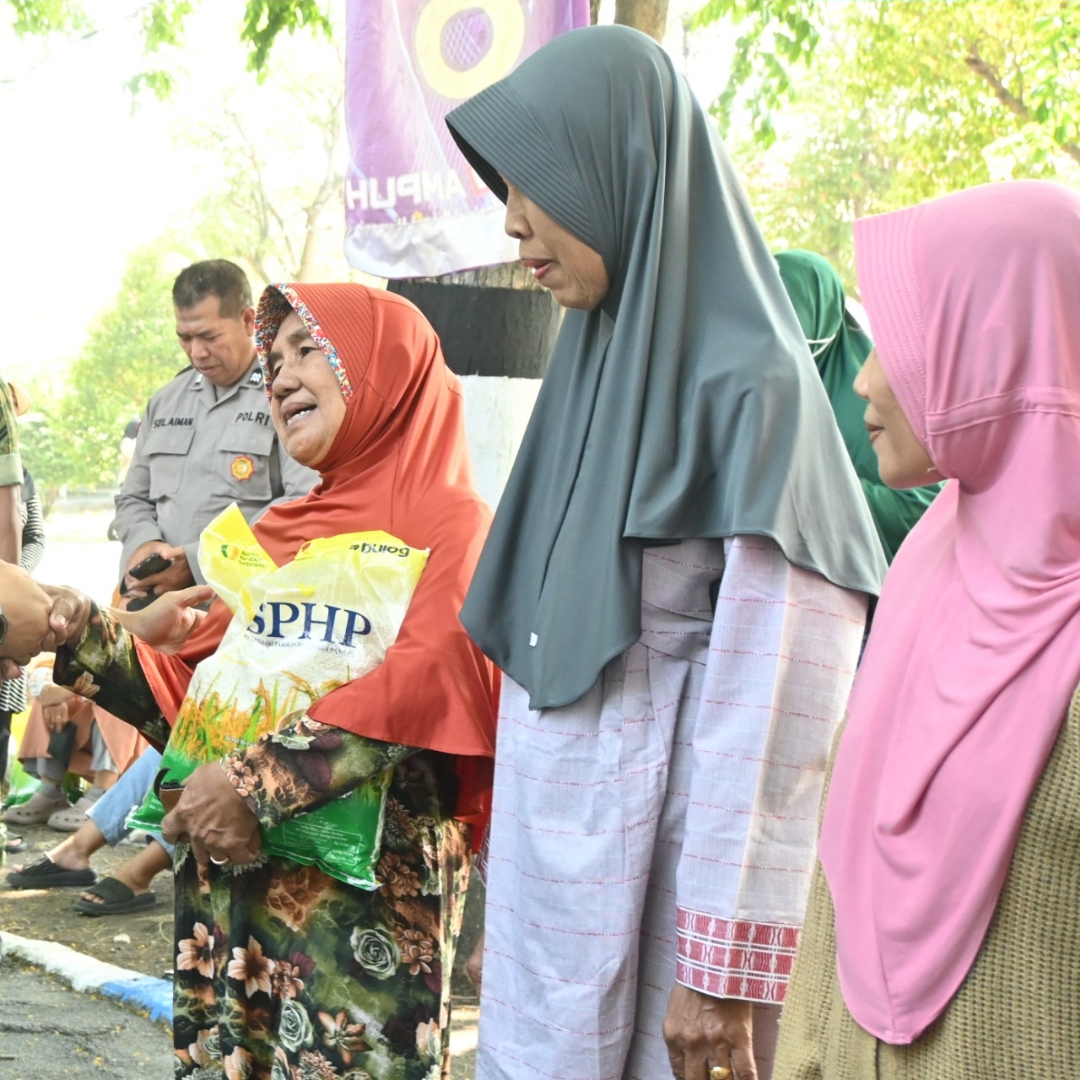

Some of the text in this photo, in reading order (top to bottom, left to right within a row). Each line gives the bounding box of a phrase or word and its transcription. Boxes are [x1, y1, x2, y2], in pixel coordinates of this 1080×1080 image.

[153, 417, 194, 428] SULAIMAN
[235, 411, 270, 426] POLRI
[247, 601, 372, 649] SPHP
